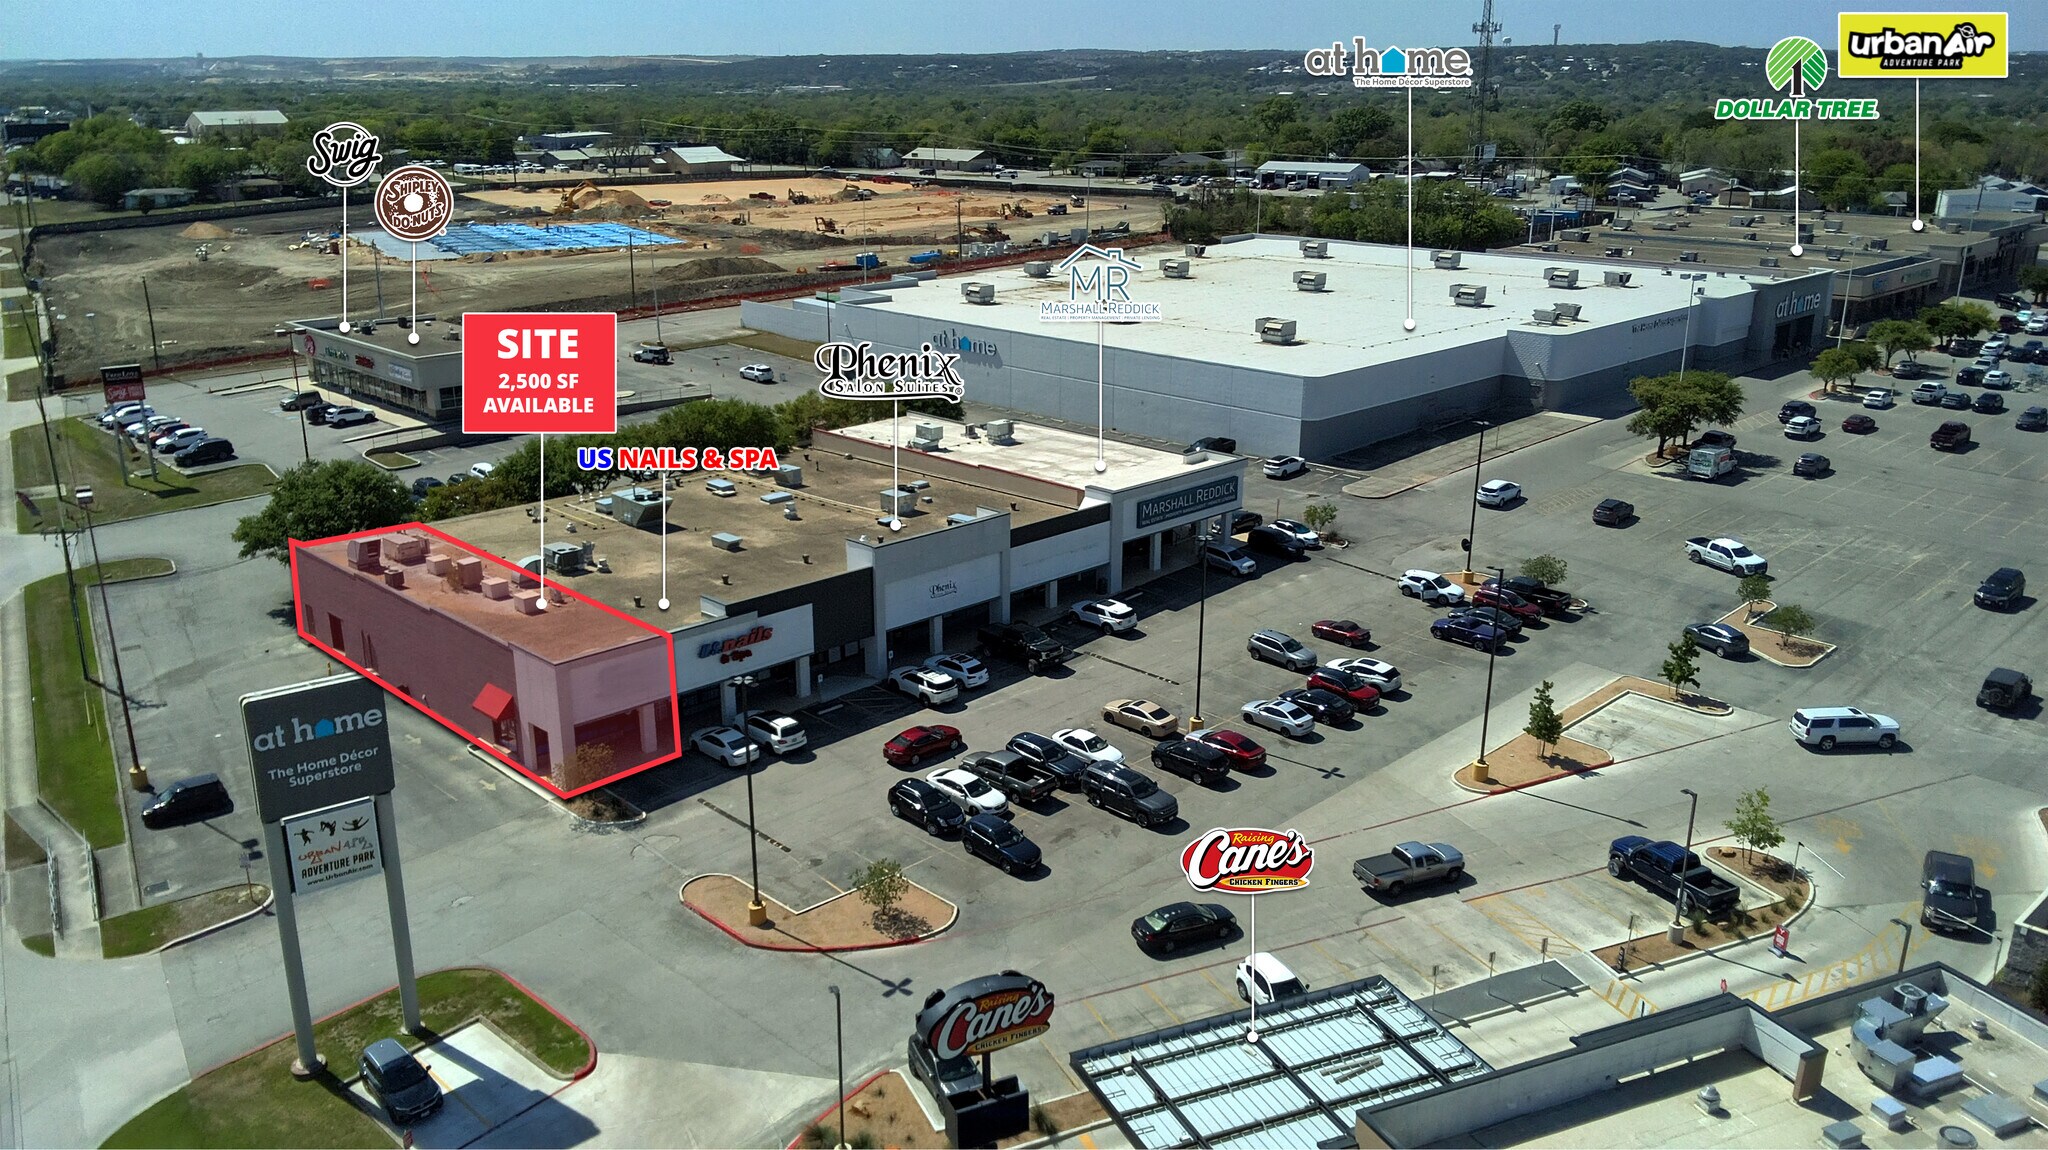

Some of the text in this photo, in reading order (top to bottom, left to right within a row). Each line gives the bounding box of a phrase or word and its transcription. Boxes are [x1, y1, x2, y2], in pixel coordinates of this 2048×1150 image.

[1776, 296, 1788, 319] at
[933, 330, 948, 348] at
[1142, 494, 1194, 518] MARSHALL
[1196, 482, 1236, 503] REDDICK
[722, 626, 773, 652] nails
[254, 725, 286, 752] at
[267, 747, 379, 781] The Home Décor
[289, 762, 362, 788] Superstore
[301, 850, 376, 879] ADVENTURE PARK
[980, 993, 1019, 1010] Raising
[937, 984, 1052, 1060] Cane's
[975, 1027, 1042, 1051] CHICKEN FINGERS
